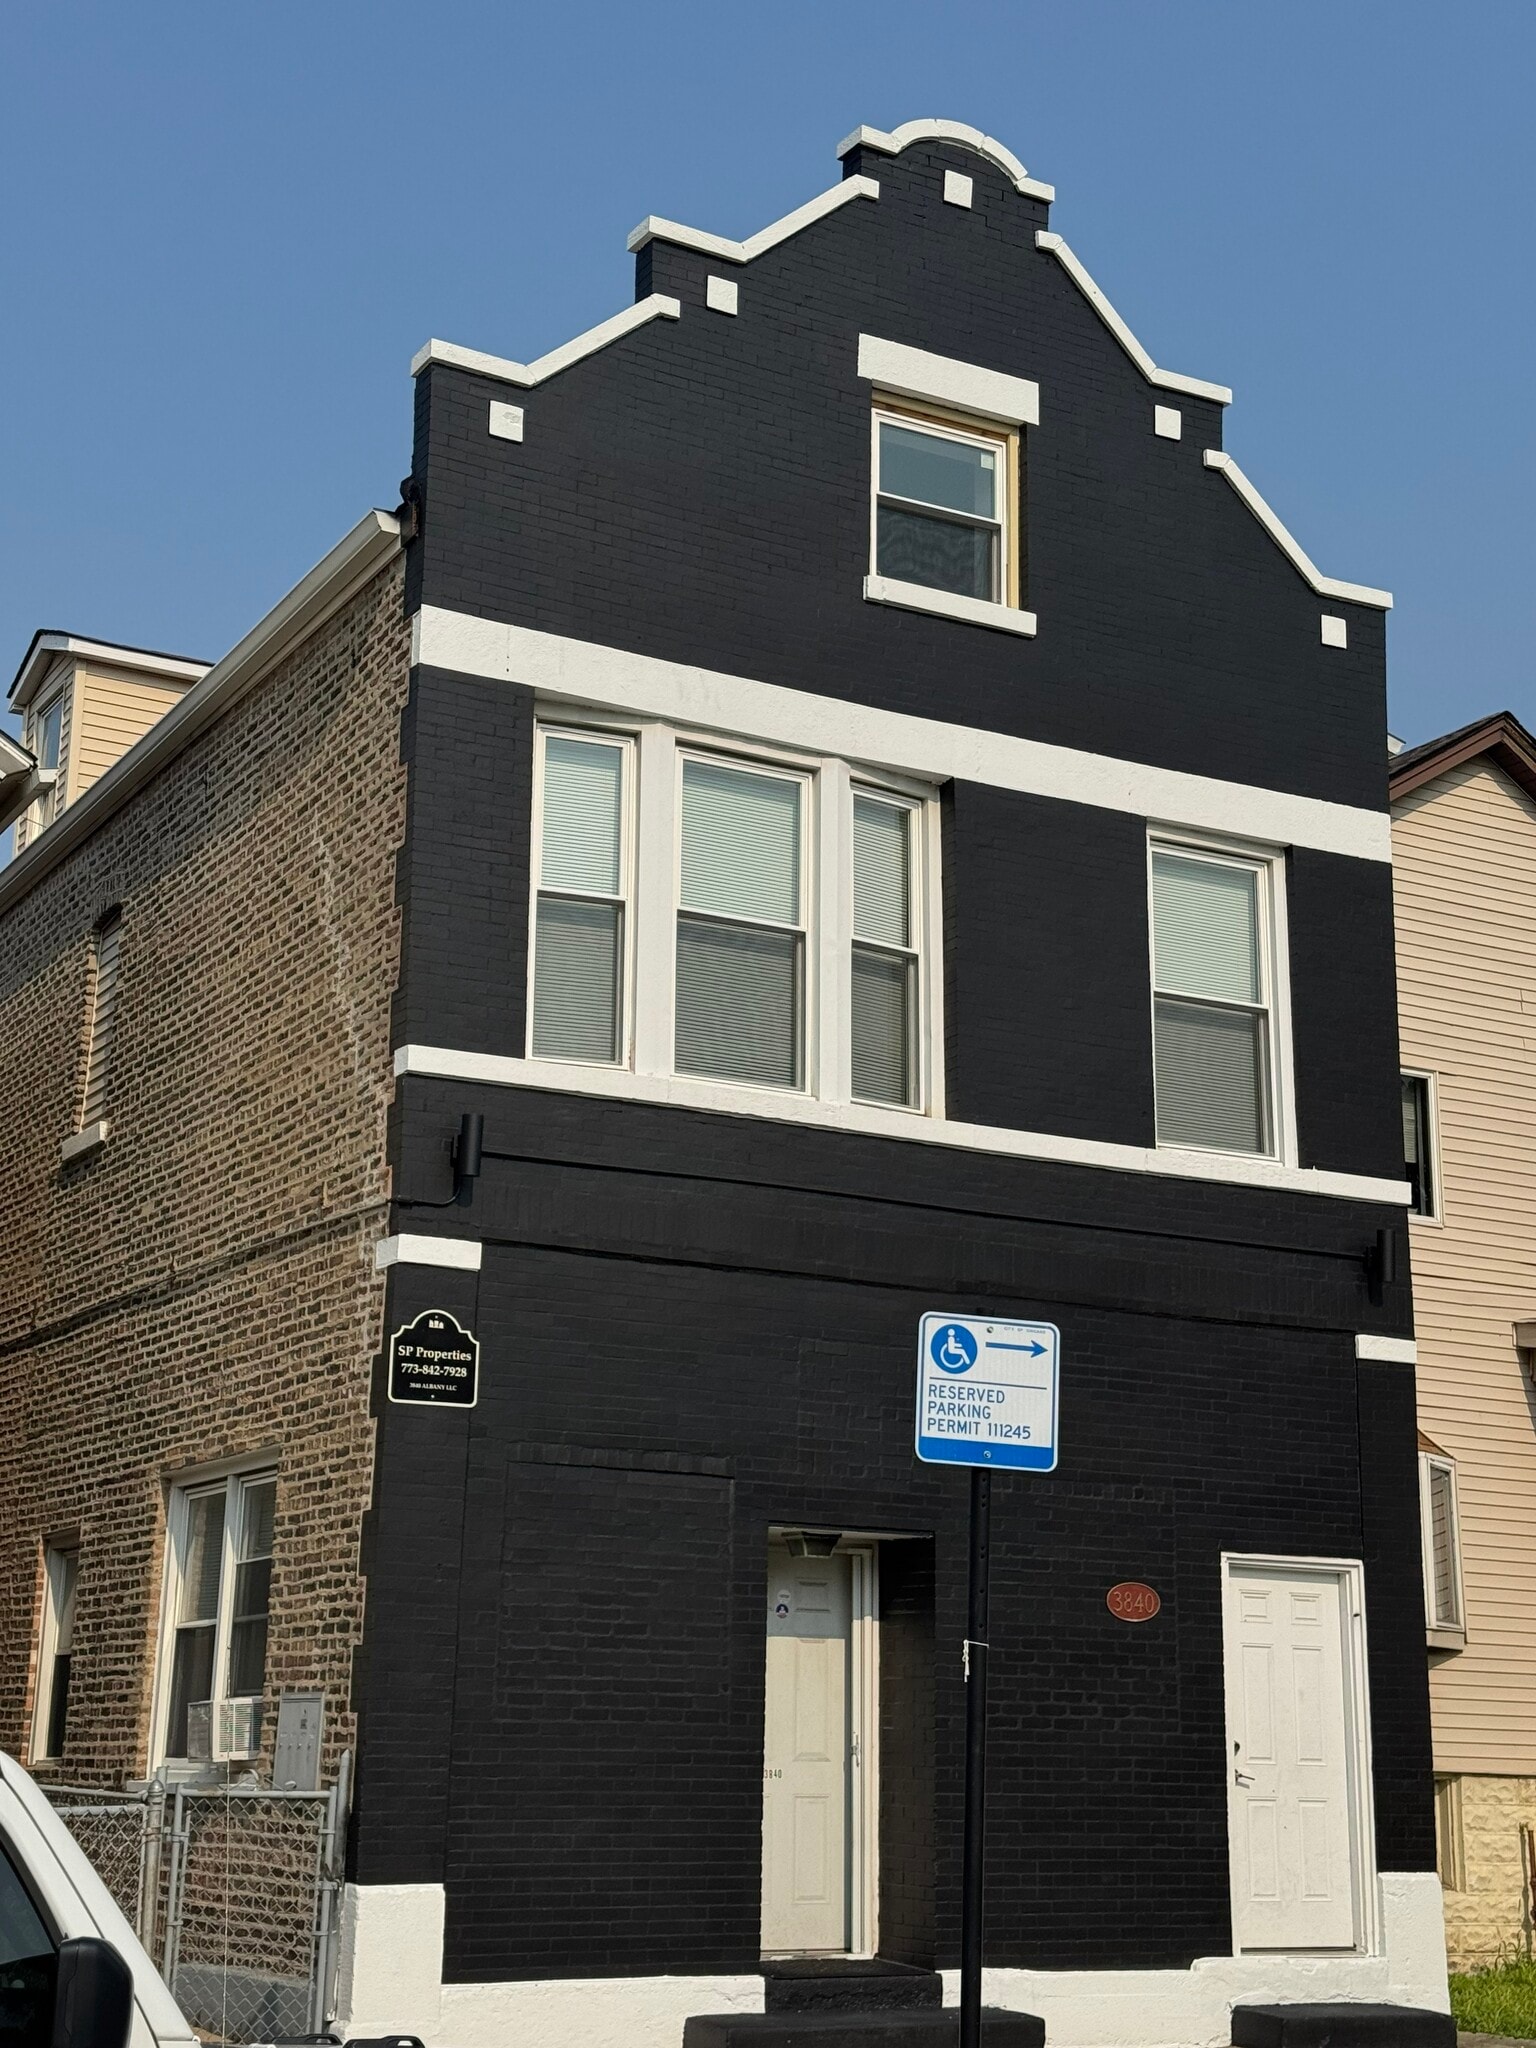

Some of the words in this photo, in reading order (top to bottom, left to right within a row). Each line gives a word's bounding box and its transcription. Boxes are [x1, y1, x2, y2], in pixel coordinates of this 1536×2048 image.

[397, 1345, 414, 1357] SP
[416, 1346, 472, 1361] Properties
[400, 1363, 467, 1377] 773-842-7928
[928, 1383, 1005, 1404] RESERVED
[927, 1400, 991, 1420] PARKING
[927, 1417, 981, 1436] PERMIT
[988, 1422, 1031, 1440] 111245
[1113, 1591, 1155, 1613] 3840
